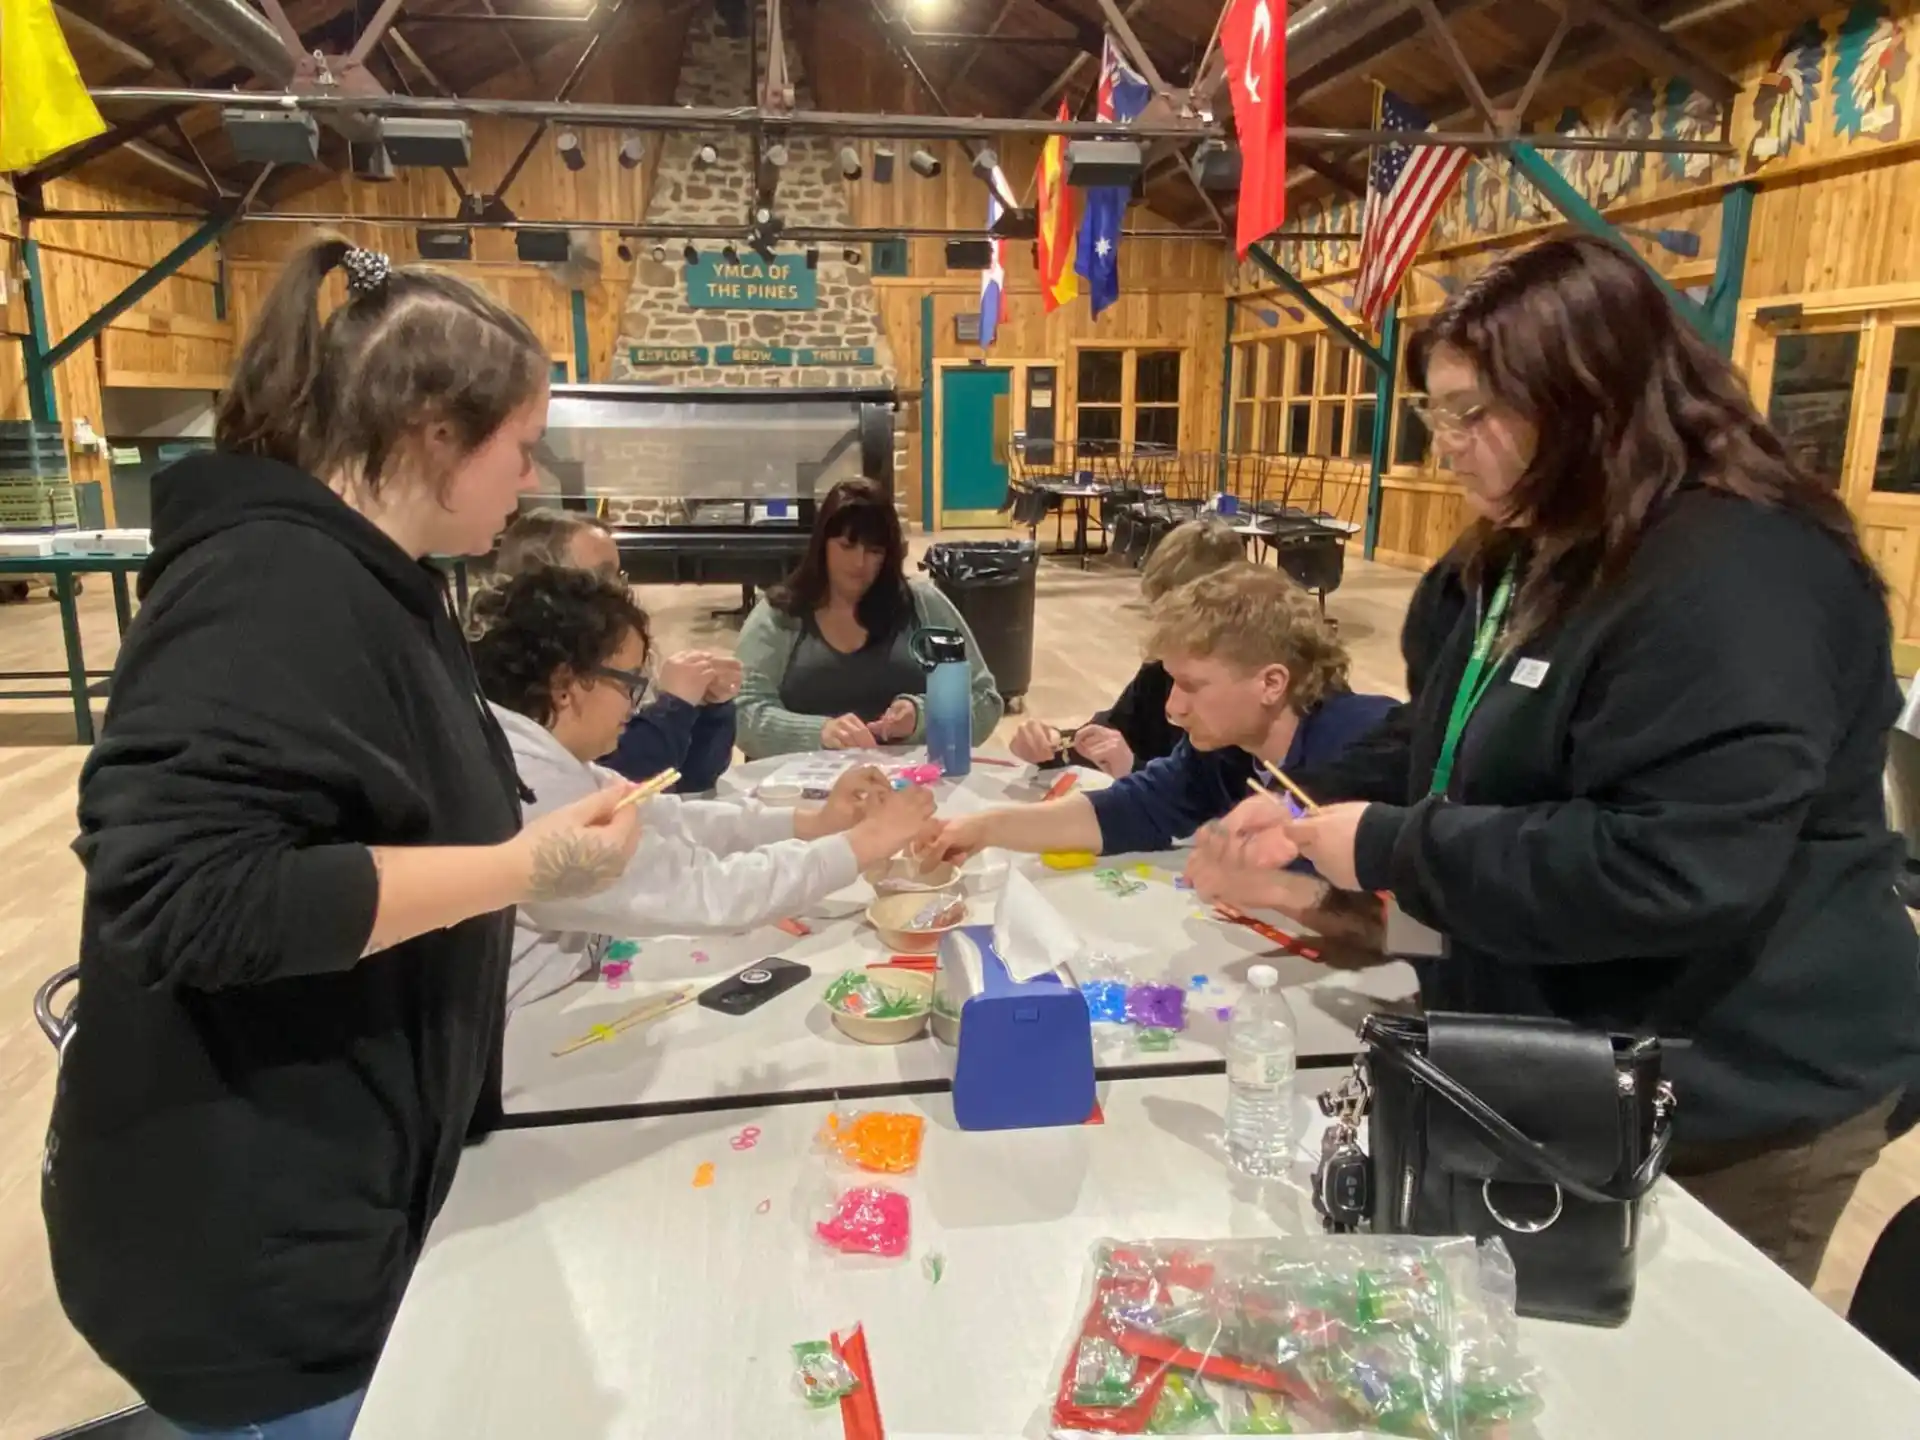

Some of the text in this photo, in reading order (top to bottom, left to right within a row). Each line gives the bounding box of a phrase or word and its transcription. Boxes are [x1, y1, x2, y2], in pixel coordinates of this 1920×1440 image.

[712, 263, 792, 280] YMCA OF
[706, 283, 799, 300] THE PINES
